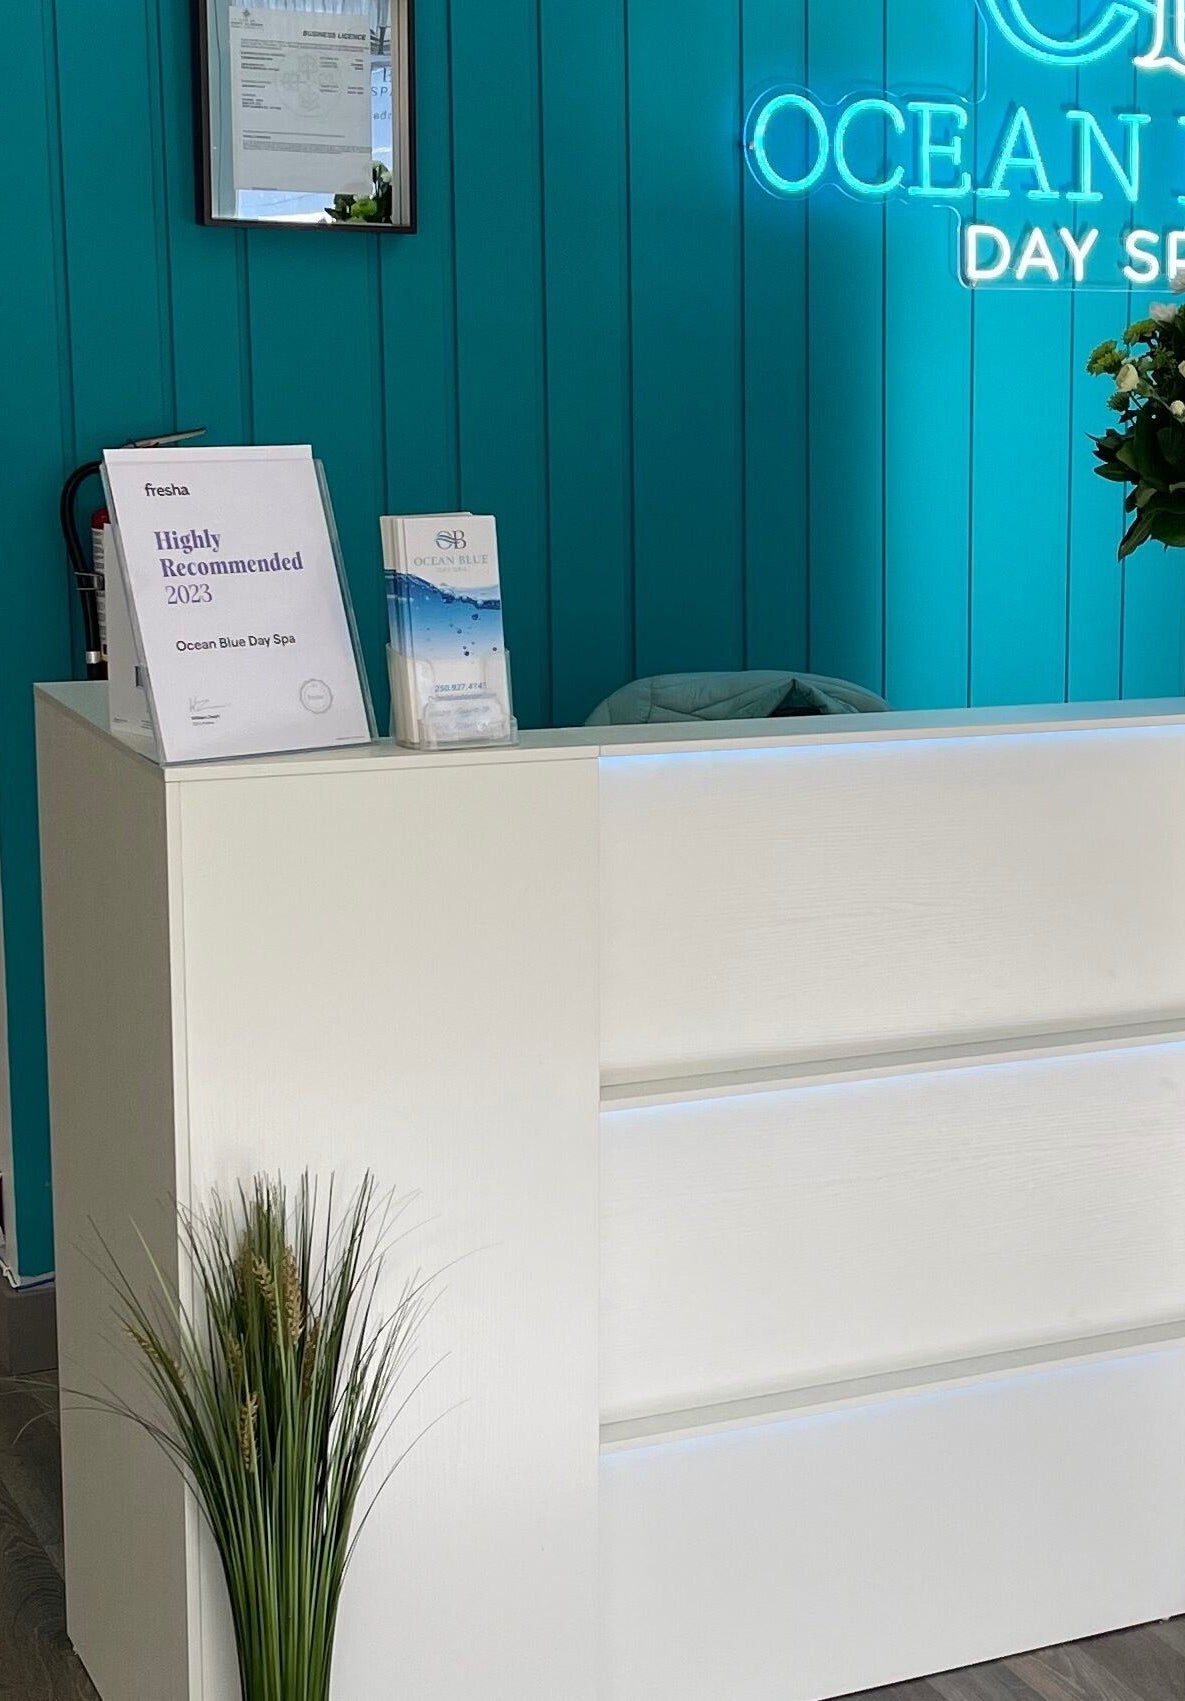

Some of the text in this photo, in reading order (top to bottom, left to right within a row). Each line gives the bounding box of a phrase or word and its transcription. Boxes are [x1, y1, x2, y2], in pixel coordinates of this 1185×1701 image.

[302, 30, 367, 41] BUSINESS LICENCE
[753, 94, 1152, 202] OCEAN
[965, 224, 1100, 283] DAY
[145, 482, 191, 497] fresha
[154, 528, 221, 554] Highly
[159, 551, 304, 578] Recommended
[413, 553, 489, 567] OCEAN BLUE
[165, 583, 213, 605] 2023
[176, 633, 296, 651] Ocean Blue Day Spa
